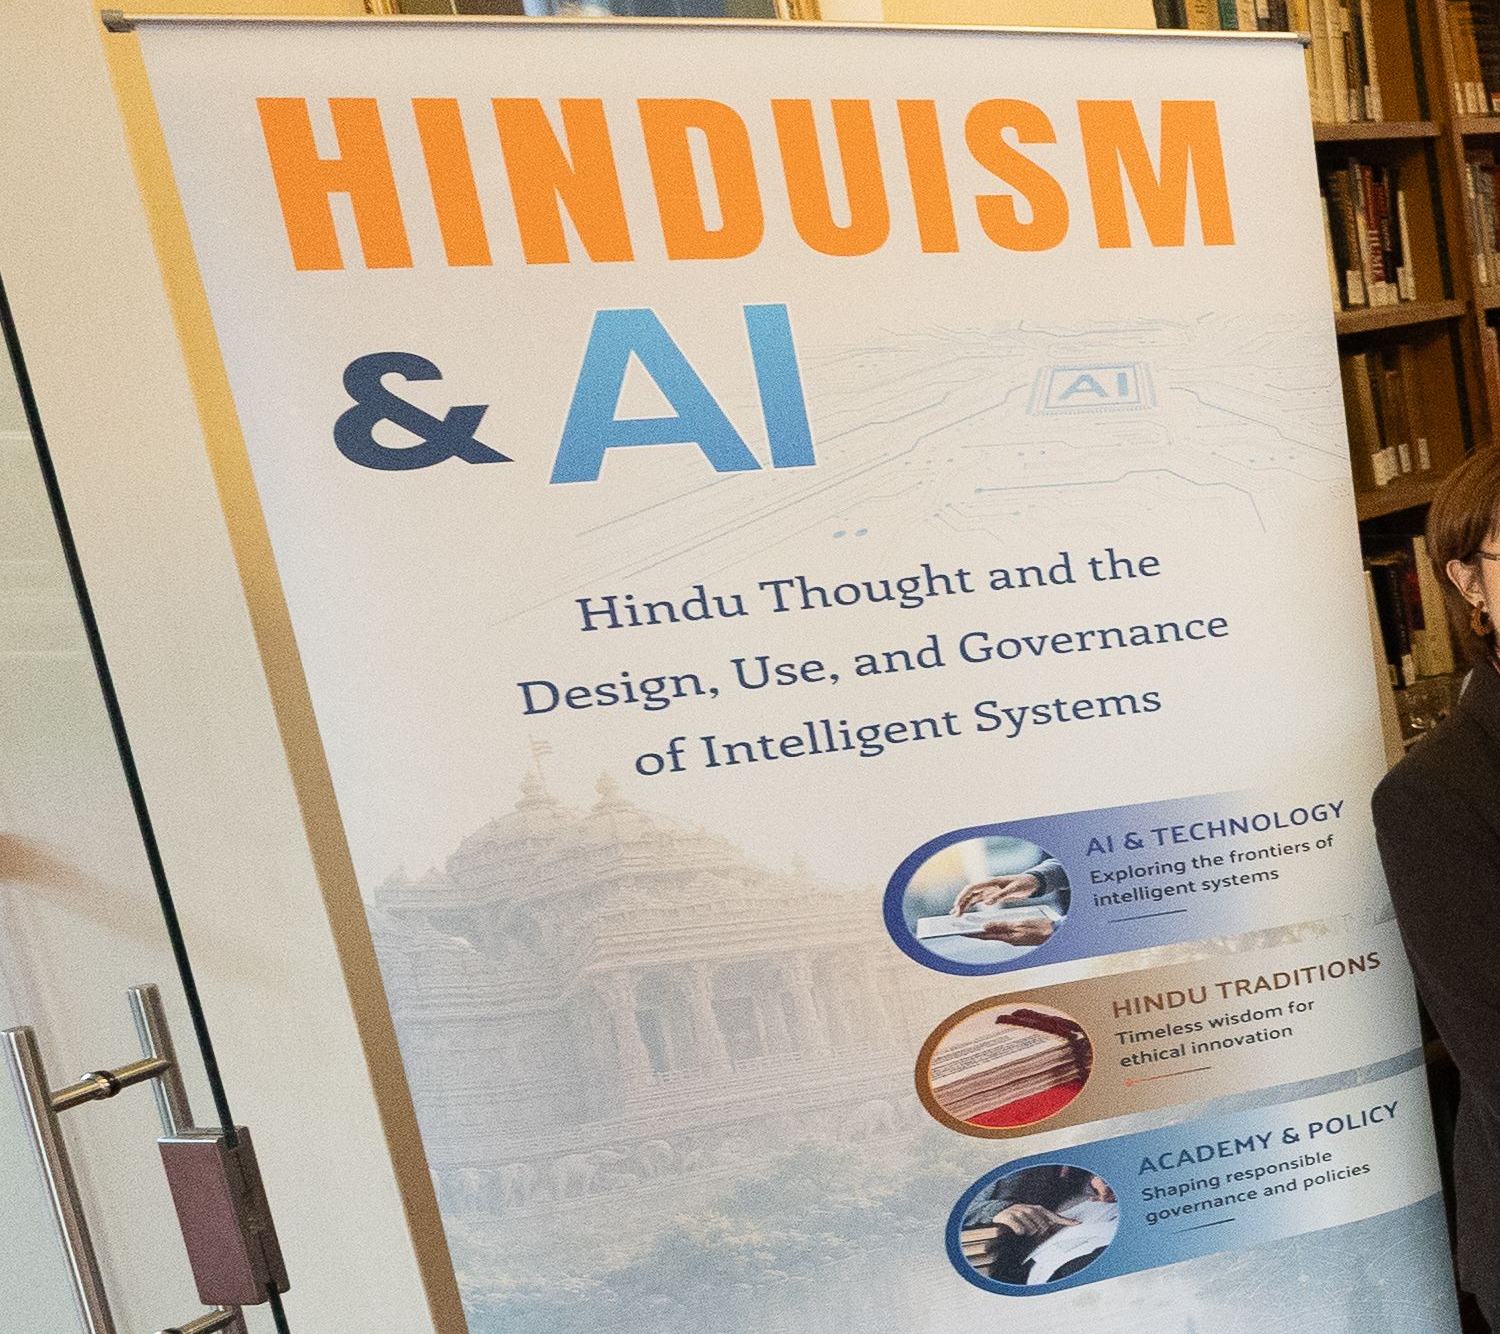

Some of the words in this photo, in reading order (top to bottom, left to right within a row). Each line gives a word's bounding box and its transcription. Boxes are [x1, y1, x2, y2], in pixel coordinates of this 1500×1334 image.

[255, 97, 1236, 271] HINDUISM
[332, 351, 515, 472] &
[548, 302, 818, 485] AI
[1058, 372, 1129, 401] AI
[577, 584, 749, 633] Hindu
[760, 563, 975, 624] Thought
[988, 555, 1073, 592] and
[1088, 545, 1163, 585] the
[518, 669, 721, 720] Design,
[734, 655, 842, 695] Use,
[853, 634, 944, 678] and
[958, 614, 1230, 665] Governance
[634, 738, 687, 779] of
[699, 708, 963, 774] Intelligent
[974, 683, 1163, 744] Systems
[1086, 834, 1114, 856] AI
[1123, 831, 1145, 850] &
[1150, 800, 1346, 847] TECHNOLOGY
[1090, 853, 1187, 885] Exploring
[1191, 851, 1225, 870] the
[1229, 839, 1310, 865] frontiers
[1314, 833, 1334, 851] of
[1093, 878, 1197, 908] intelligent
[1201, 867, 1280, 893] systems
[1112, 985, 1209, 1019] HINDU
[1215, 951, 1381, 1000] TRADITIONS
[1116, 1019, 1204, 1046] Timeless
[1207, 1003, 1284, 1030] wisdom
[1288, 997, 1315, 1016] for
[1119, 1042, 1186, 1069] ethical
[1191, 1024, 1293, 1055] innovation
[1138, 1130, 1273, 1175] ACADEMY
[1281, 1125, 1301, 1144] &
[1307, 1100, 1399, 1141] POLICY
[1141, 1172, 1221, 1202] Shaping
[1226, 1149, 1333, 1181] responsible
[1146, 1189, 1258, 1225] governance
[1262, 1178, 1298, 1198] and
[1302, 1161, 1371, 1193] policies
